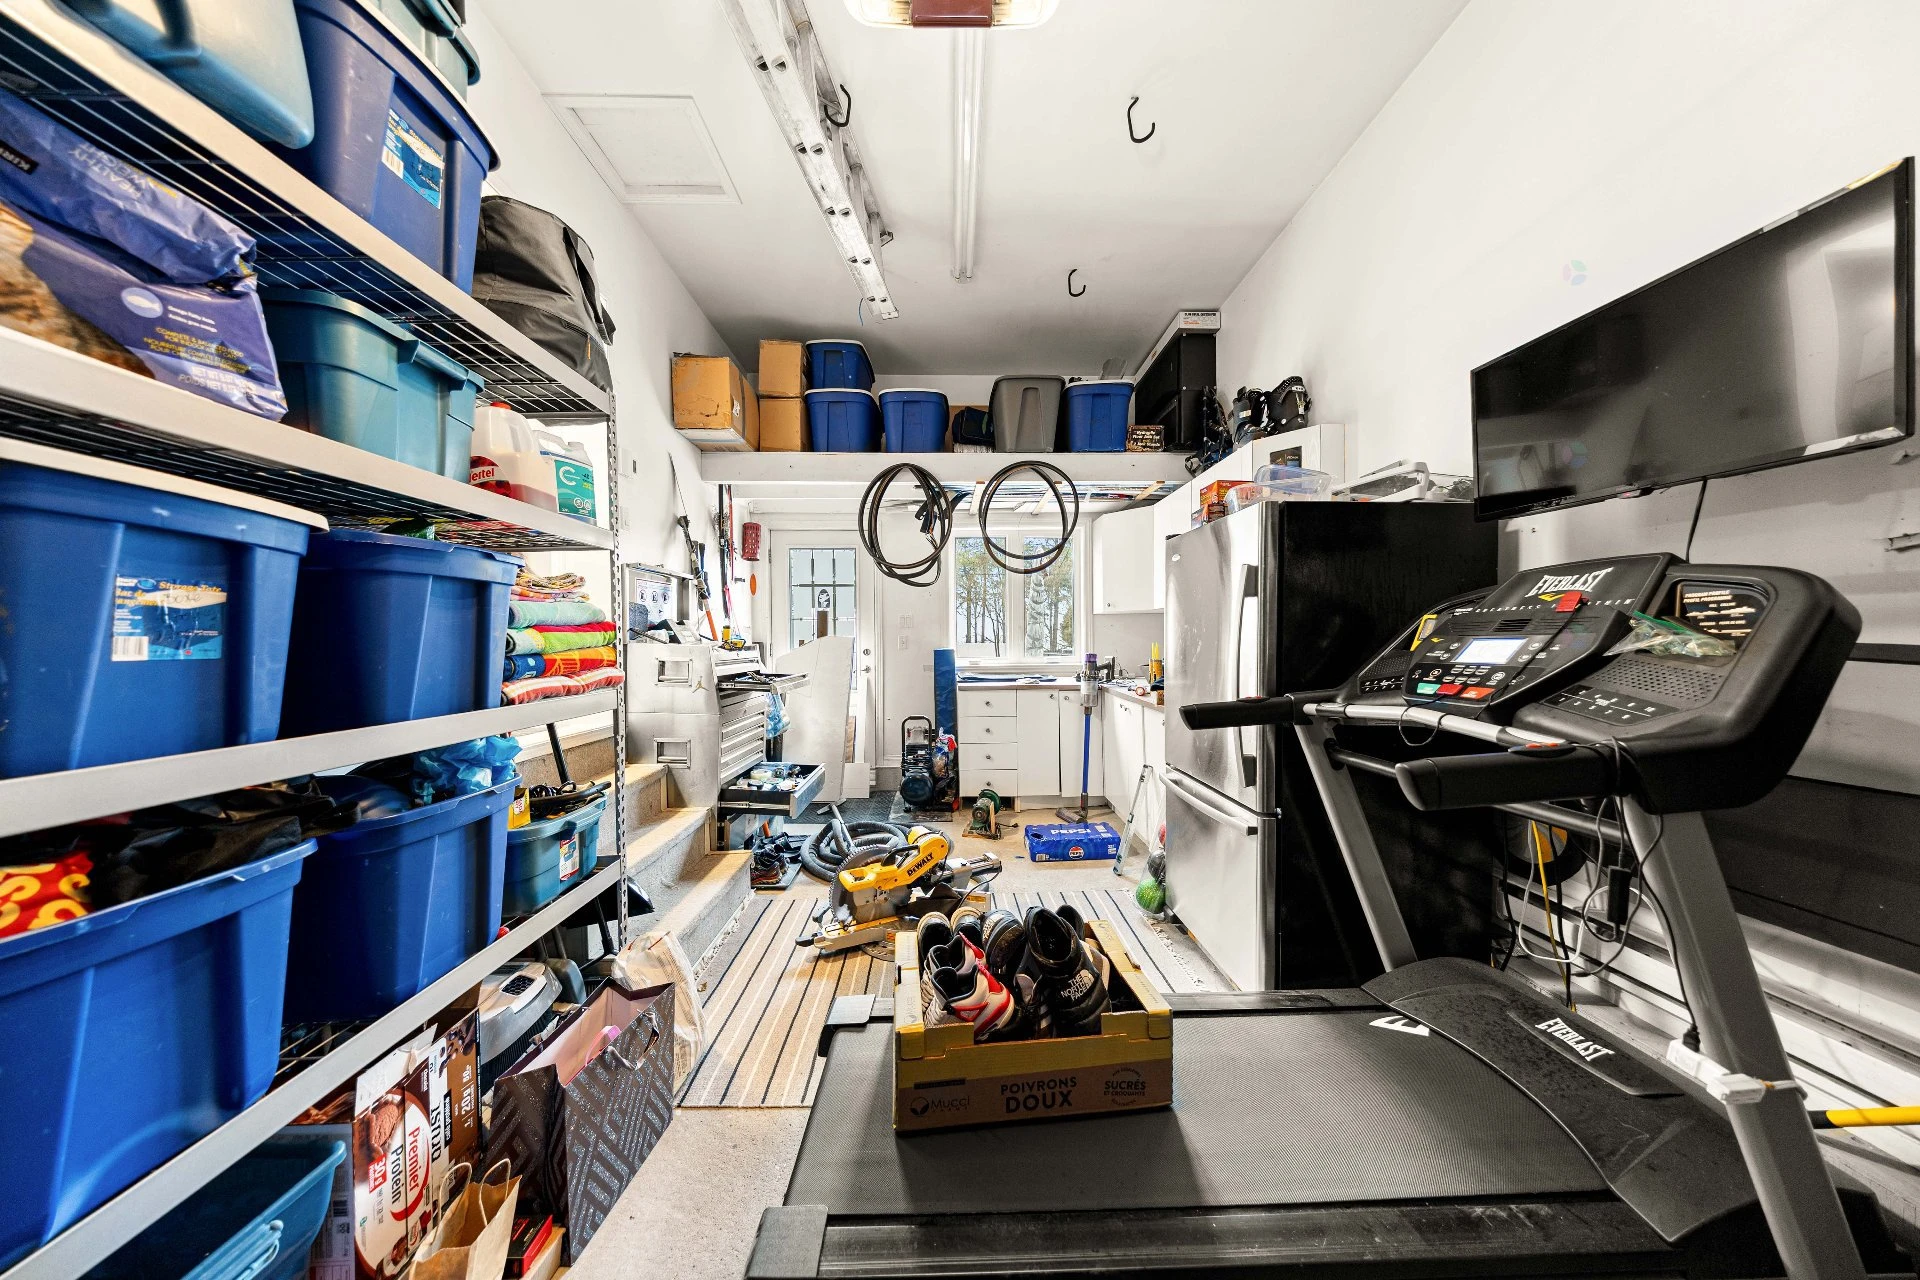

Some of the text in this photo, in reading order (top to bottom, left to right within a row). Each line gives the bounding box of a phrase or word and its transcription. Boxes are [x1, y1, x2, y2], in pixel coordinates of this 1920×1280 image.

[1524, 566, 1614, 598] EVERLAST
[906, 852, 934, 877] DEWALT
[1060, 979, 1086, 998] NORTH
[1068, 973, 1084, 986] THE
[1070, 983, 1091, 1001] FACE
[1534, 1017, 1616, 1062] EVERLAST
[1000, 1076, 1078, 1096] POIVRONS
[1104, 1079, 1147, 1091] SUCRÉS
[1005, 1090, 1073, 1114] DOUX
[408, 1126, 421, 1193] Premier
[391, 1144, 404, 1205] Protein
